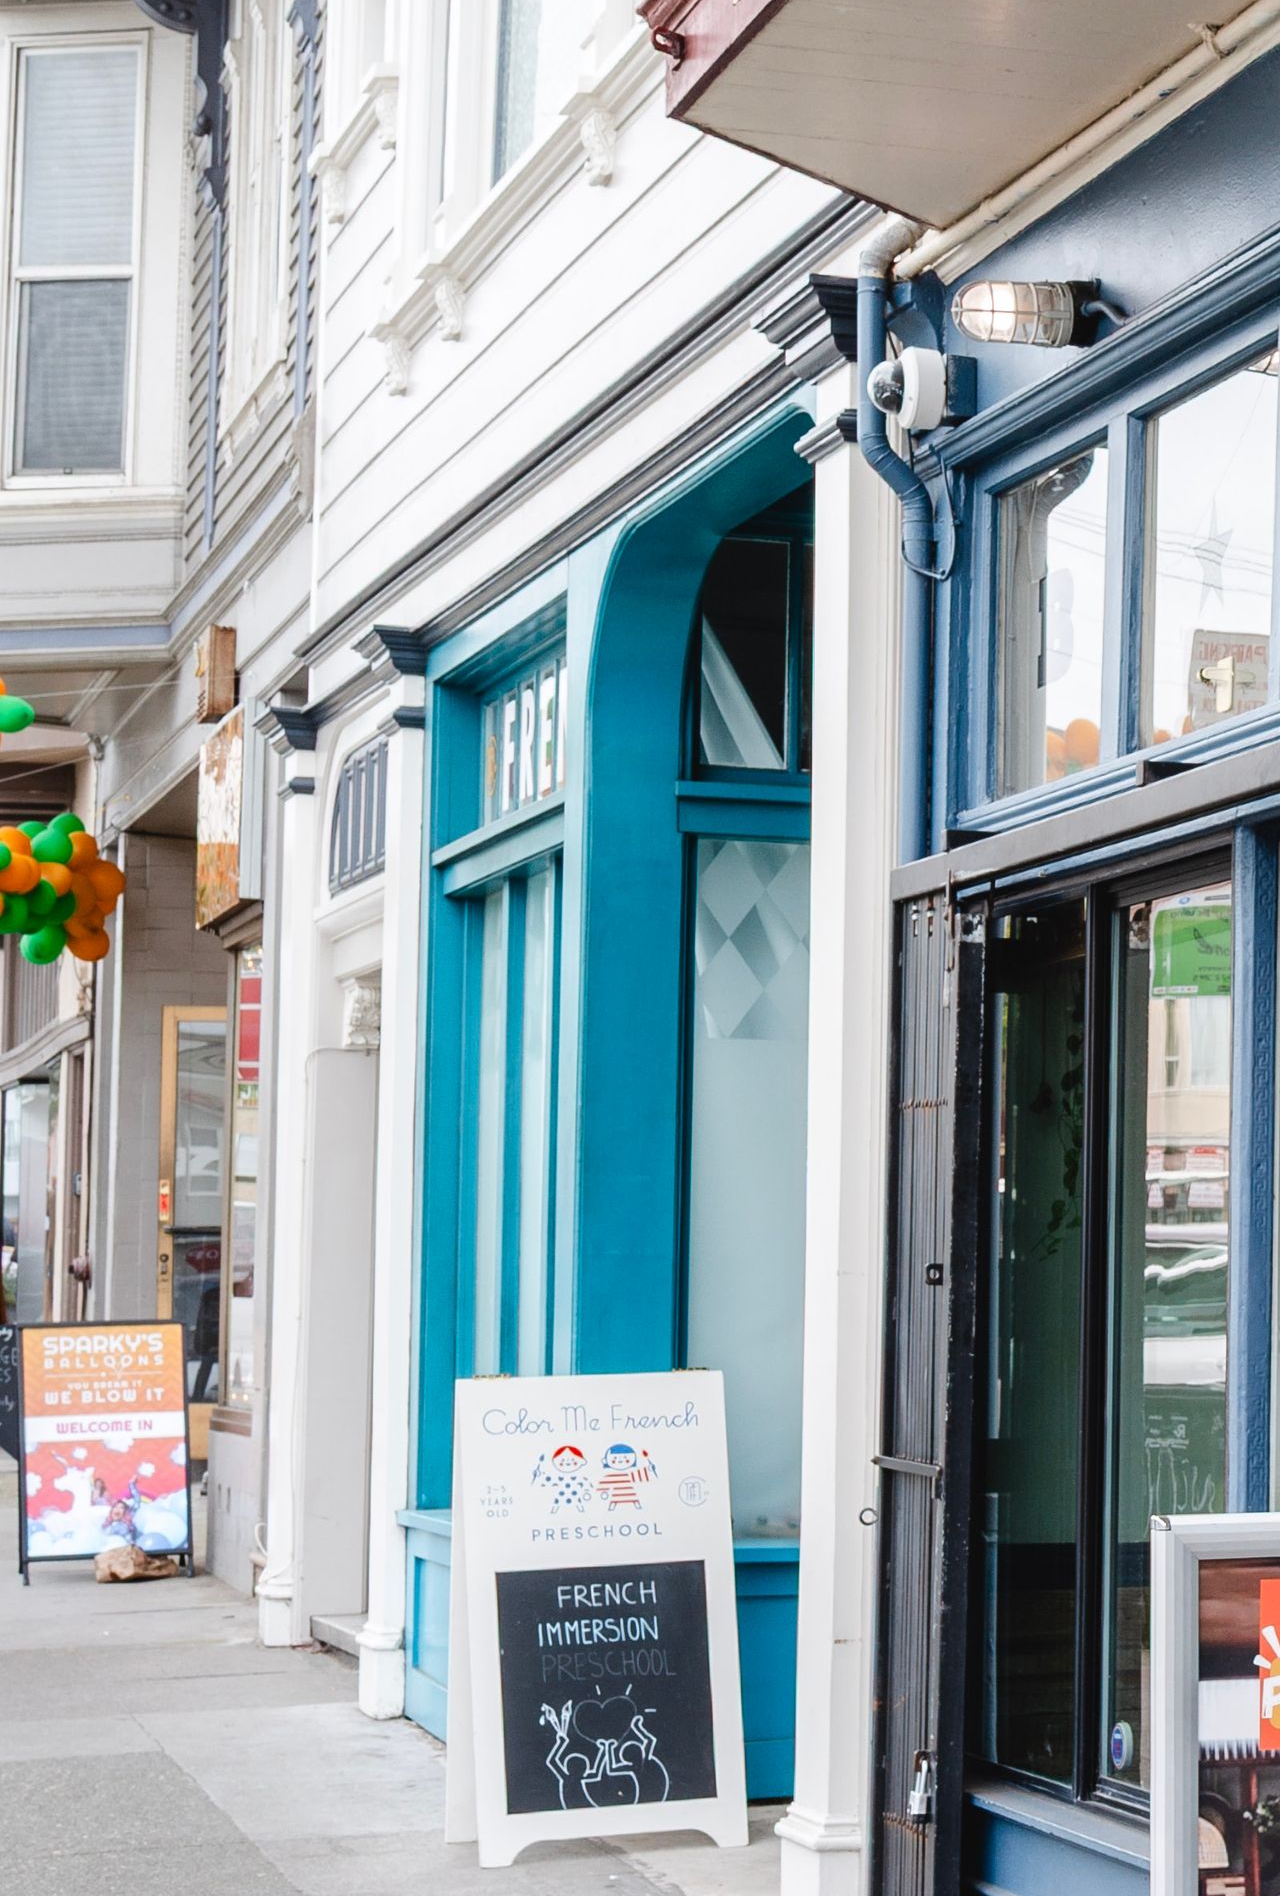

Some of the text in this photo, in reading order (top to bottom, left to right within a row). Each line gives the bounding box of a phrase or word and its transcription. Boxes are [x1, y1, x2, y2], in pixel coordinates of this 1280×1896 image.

[42, 1332, 164, 1355] SPARKY'S
[43, 1354, 164, 1370] BALLOONS
[44, 1388, 165, 1405] WE BLOW IT
[57, 1419, 153, 1434] WELCOME IN
[482, 1401, 698, 1435] Color Me French
[480, 1496, 514, 1506] YEARS
[486, 1508, 509, 1519] OLD
[532, 1522, 663, 1542] PRESCHOOL
[557, 1580, 657, 1608] FRENCH
[538, 1615, 659, 1647] IMMERSION
[541, 1648, 677, 1683] PRESCHOOL
